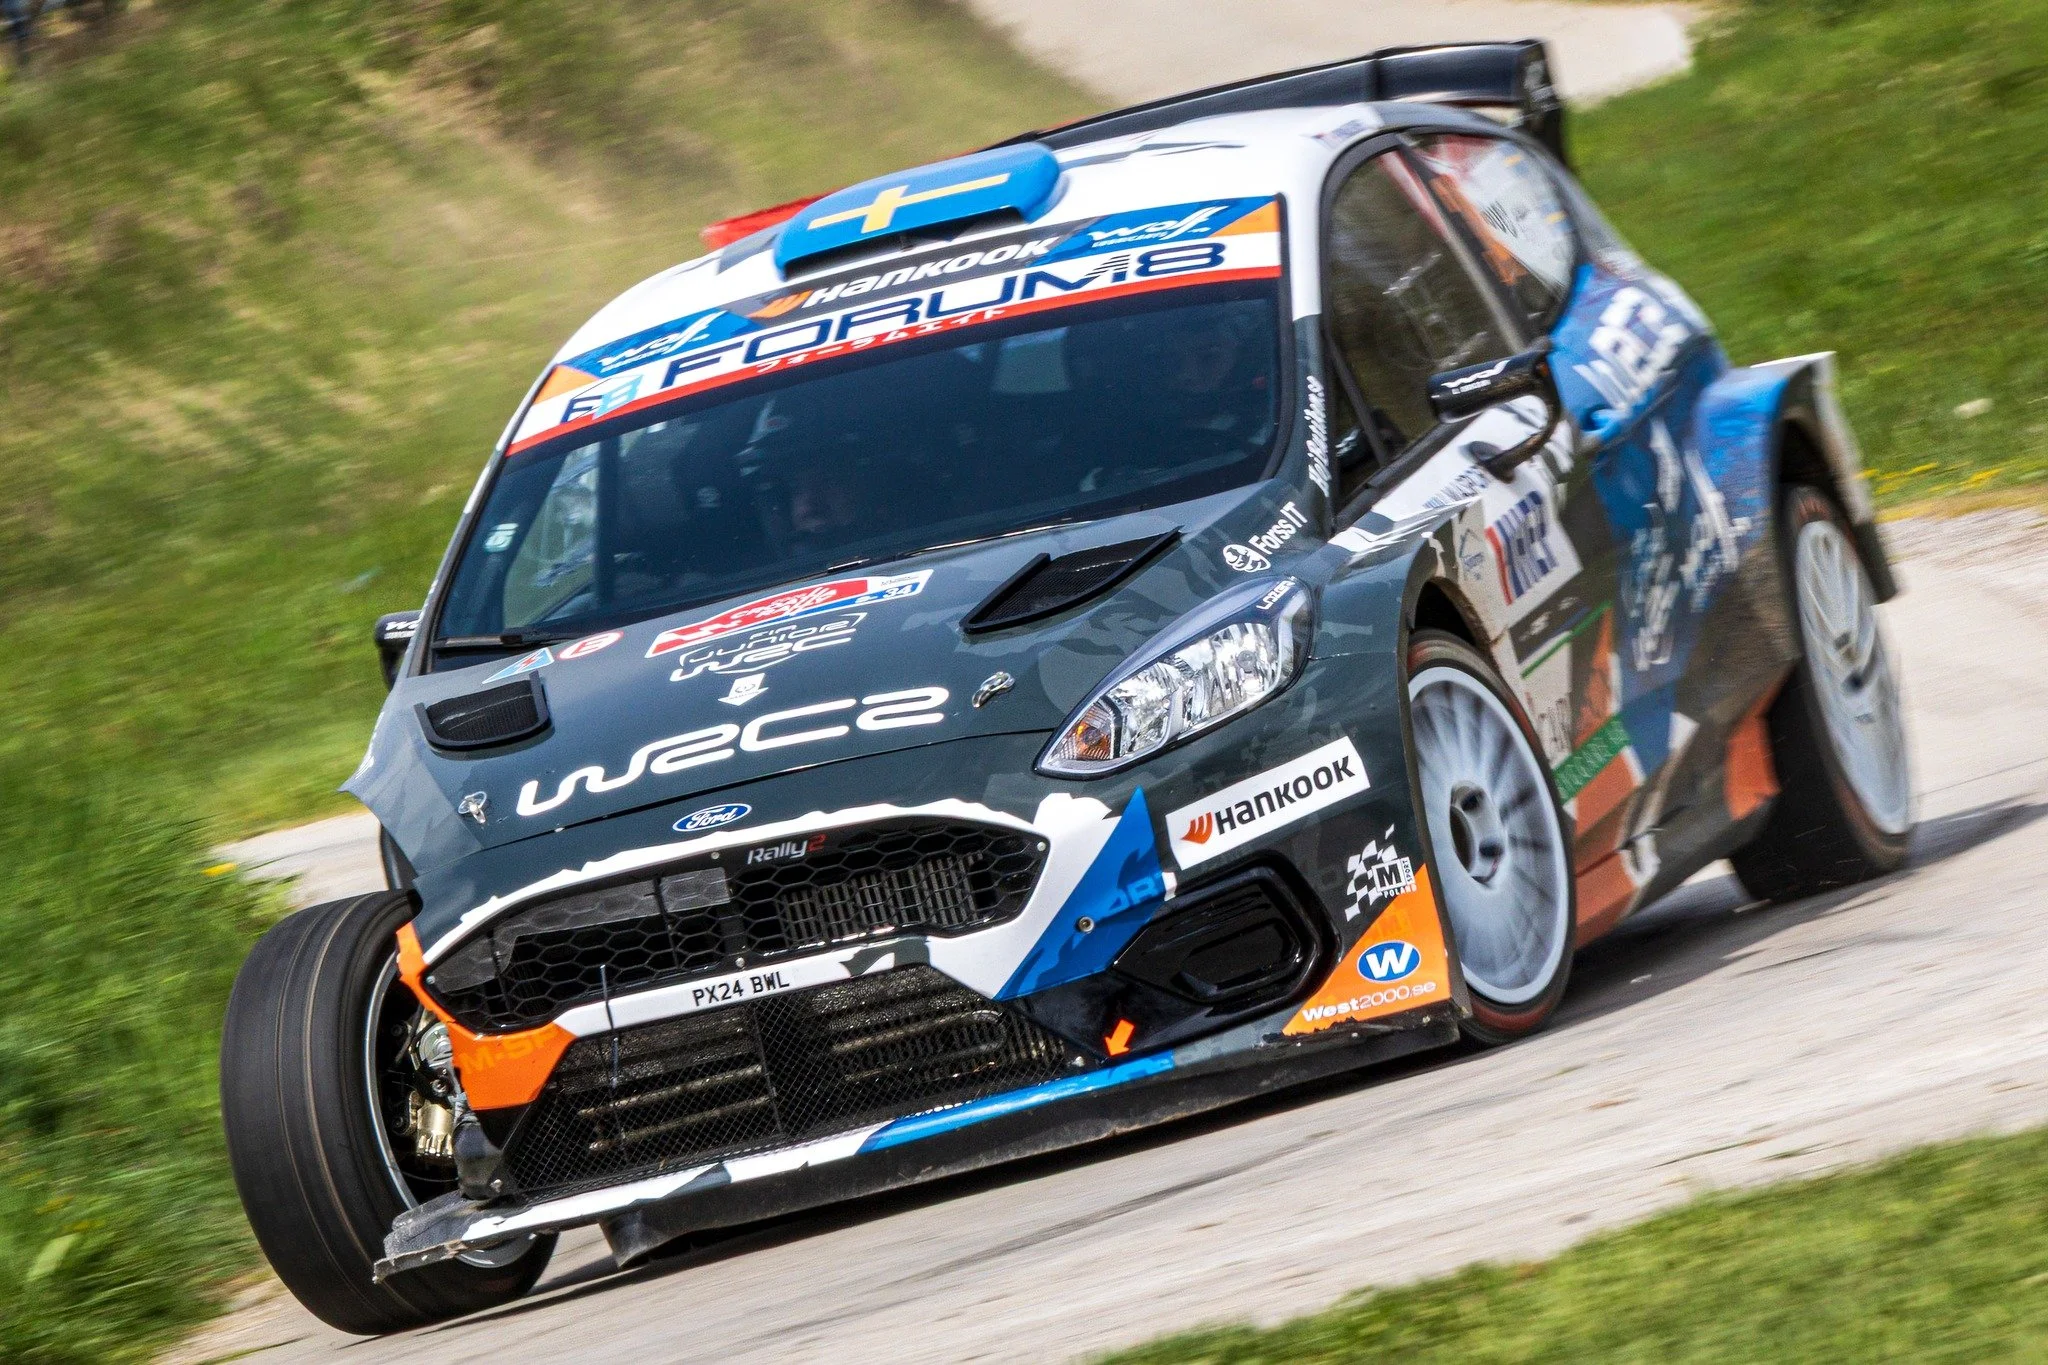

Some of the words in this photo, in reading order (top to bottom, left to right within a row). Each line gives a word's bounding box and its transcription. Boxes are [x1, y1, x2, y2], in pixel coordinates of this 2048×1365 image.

[660, 242, 1226, 391] FORUM8
[669, 628, 857, 682] WRC
[516, 686, 950, 816] WRC2
[686, 807, 738, 830] Ford
[747, 833, 827, 865] Rally2
[1377, 865, 1403, 888] M
[1402, 859, 1414, 883] SPORT
[1384, 883, 1418, 899] POLAND
[1365, 942, 1416, 980] W
[692, 979, 744, 1007] PX24
[751, 970, 790, 995] BWL
[1302, 981, 1437, 1022] West2000.se
